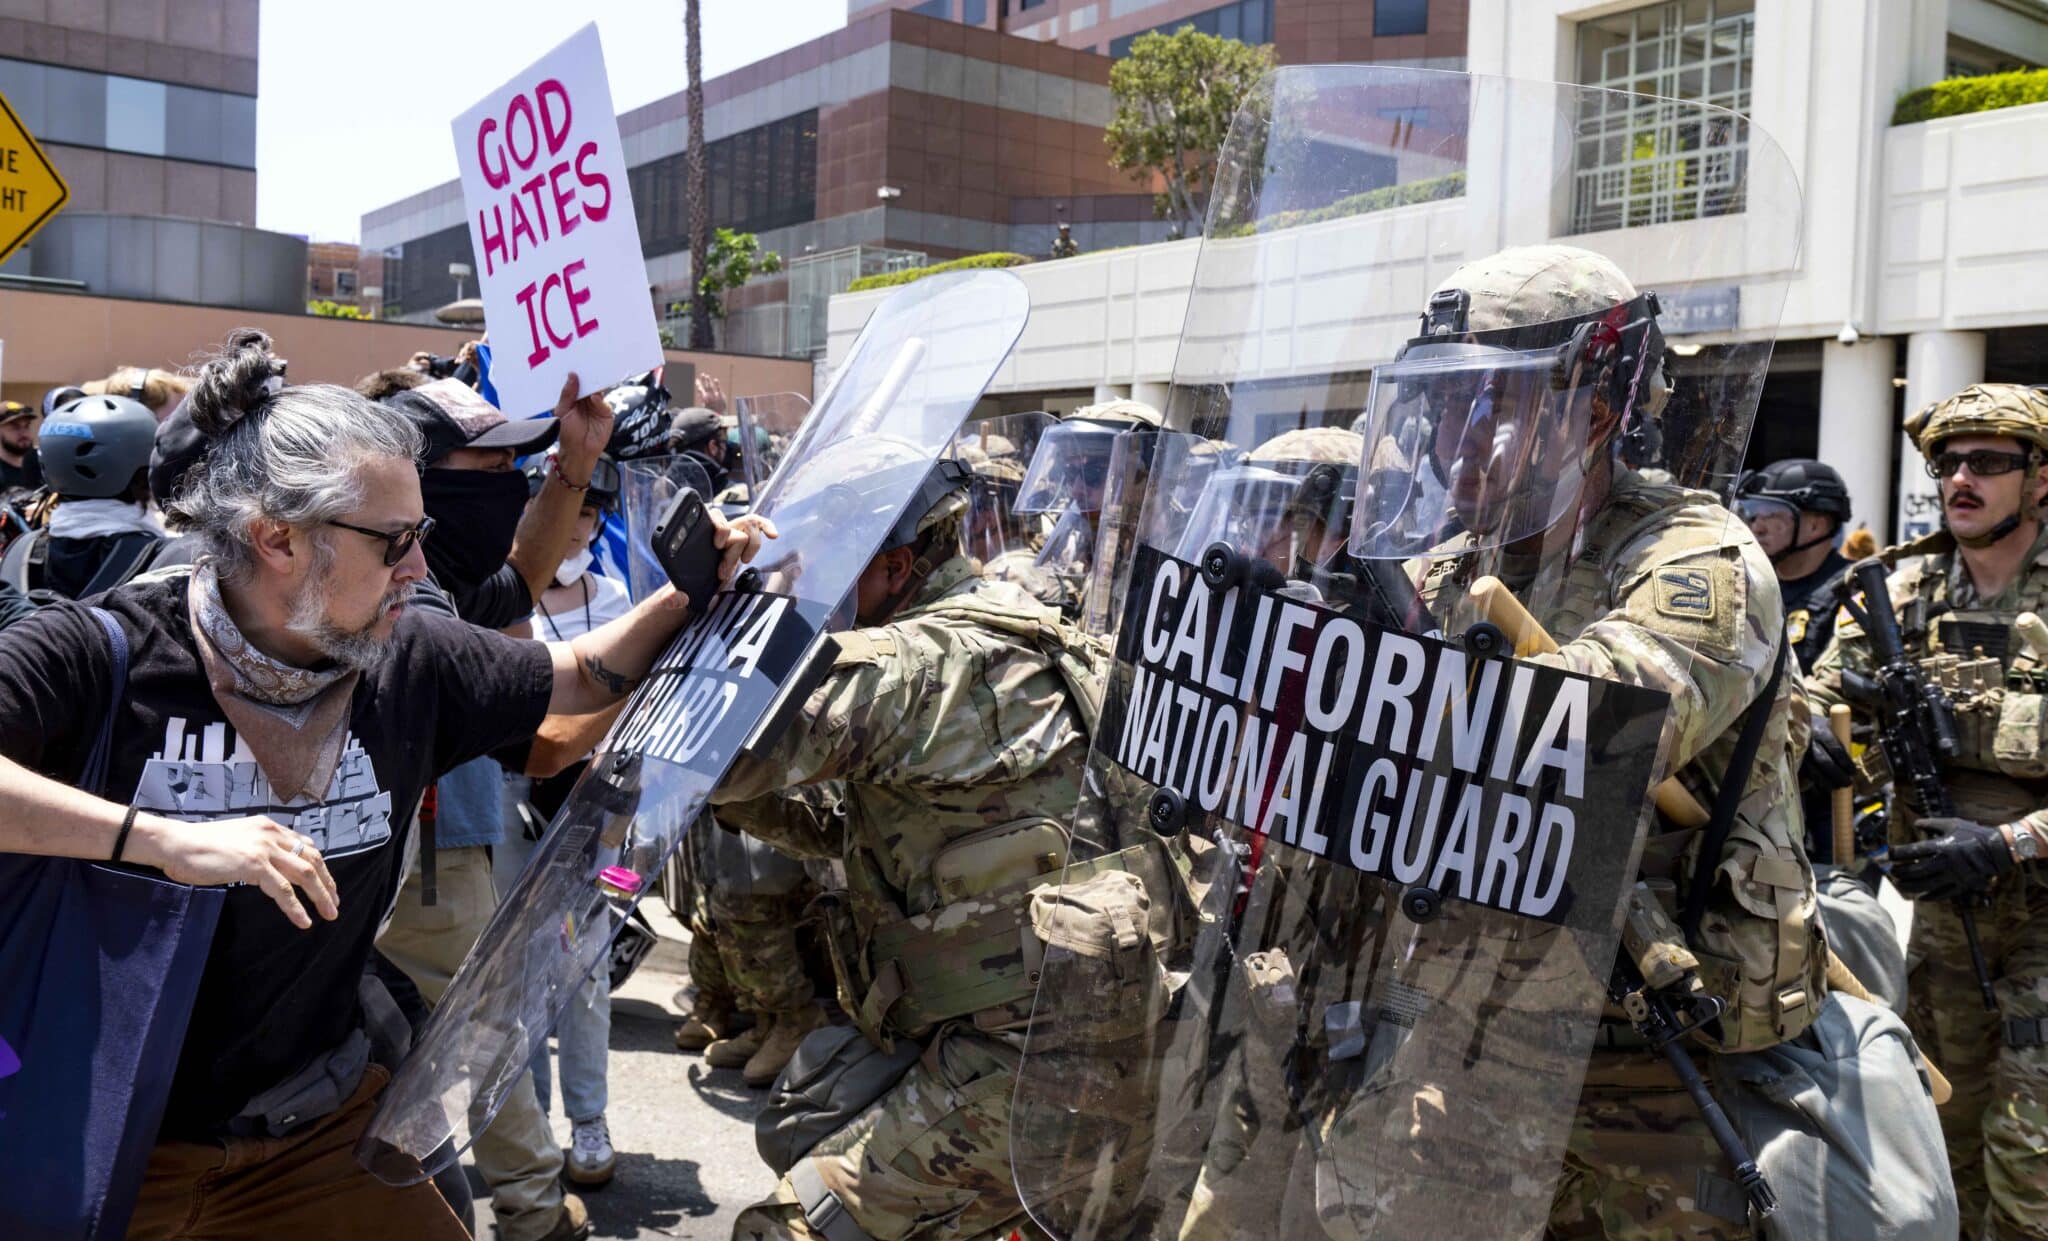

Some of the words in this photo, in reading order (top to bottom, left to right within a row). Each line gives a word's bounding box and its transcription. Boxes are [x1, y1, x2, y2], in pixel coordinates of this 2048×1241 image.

[478, 79, 572, 189] GOD
[479, 141, 611, 277] HATES
[516, 258, 599, 369] ICE
[612, 673, 738, 764] GUARD
[1143, 559, 1591, 798] CALIFORNIA
[1118, 665, 1335, 857] NATIONAL
[1349, 758, 1576, 918] GUARD
